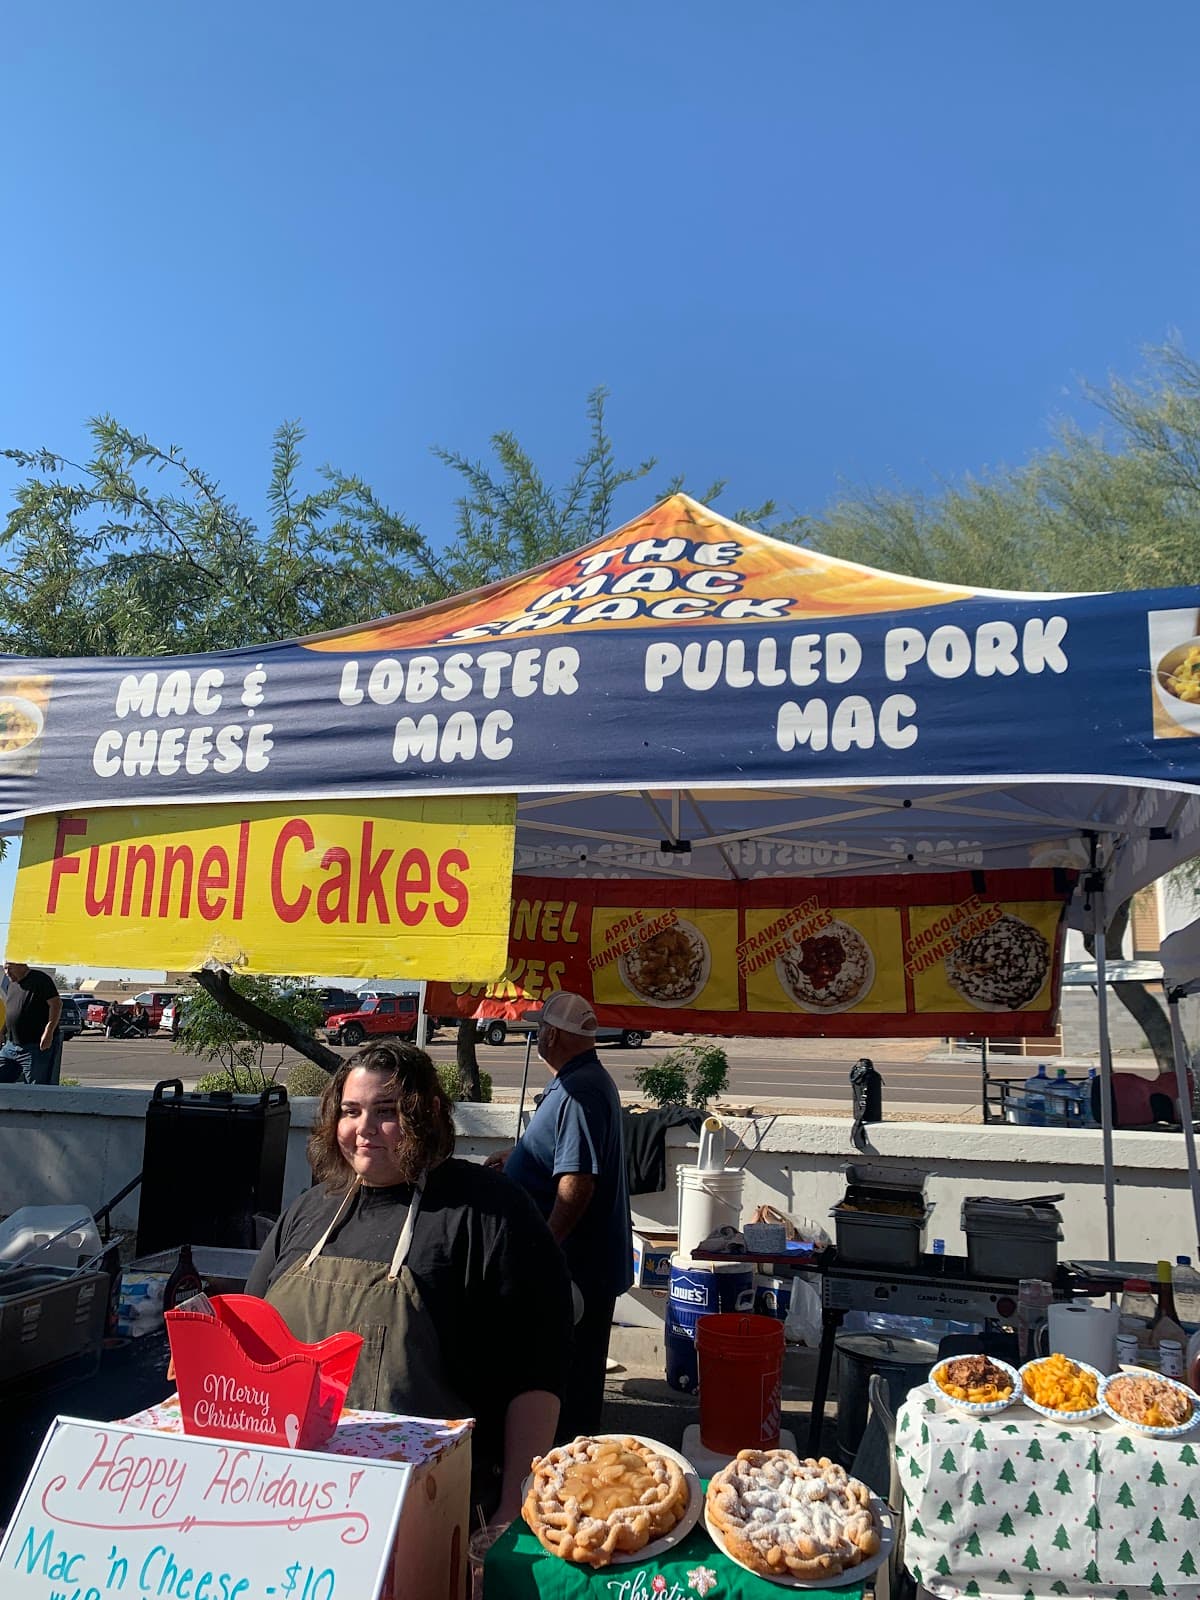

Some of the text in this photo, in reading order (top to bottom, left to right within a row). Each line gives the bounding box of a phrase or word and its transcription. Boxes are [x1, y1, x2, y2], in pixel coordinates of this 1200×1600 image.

[580, 538, 740, 576] THE
[529, 567, 743, 611] MAC
[436, 597, 793, 643] SHACK
[338, 646, 581, 706] LOBSTER
[645, 616, 1069, 692] PULLED PORK
[115, 664, 267, 719] MAC &
[93, 723, 274, 778] CHEESE
[392, 709, 514, 764] MAC
[776, 694, 918, 752] MAC
[46, 817, 470, 928] Funnel Cakes
[511, 899, 579, 943] NEL
[588, 908, 678, 972] FUNNEL CAKES
[603, 910, 645, 943] APPLE
[735, 895, 821, 961] STRAWBERRY
[738, 908, 834, 978] FUNNEL CAKES
[905, 895, 981, 955] CHOCOLATE
[905, 902, 1004, 978] FUNNEL CAKES
[671, 1285, 705, 1303] LOWE'S
[194, 1400, 277, 1434] Christmas
[204, 1374, 270, 1416] Merry
[77, 1432, 365, 1531] Happy Holidays!
[14, 1526, 85, 1583] Mac
[139, 1545, 250, 1600] Cheese
